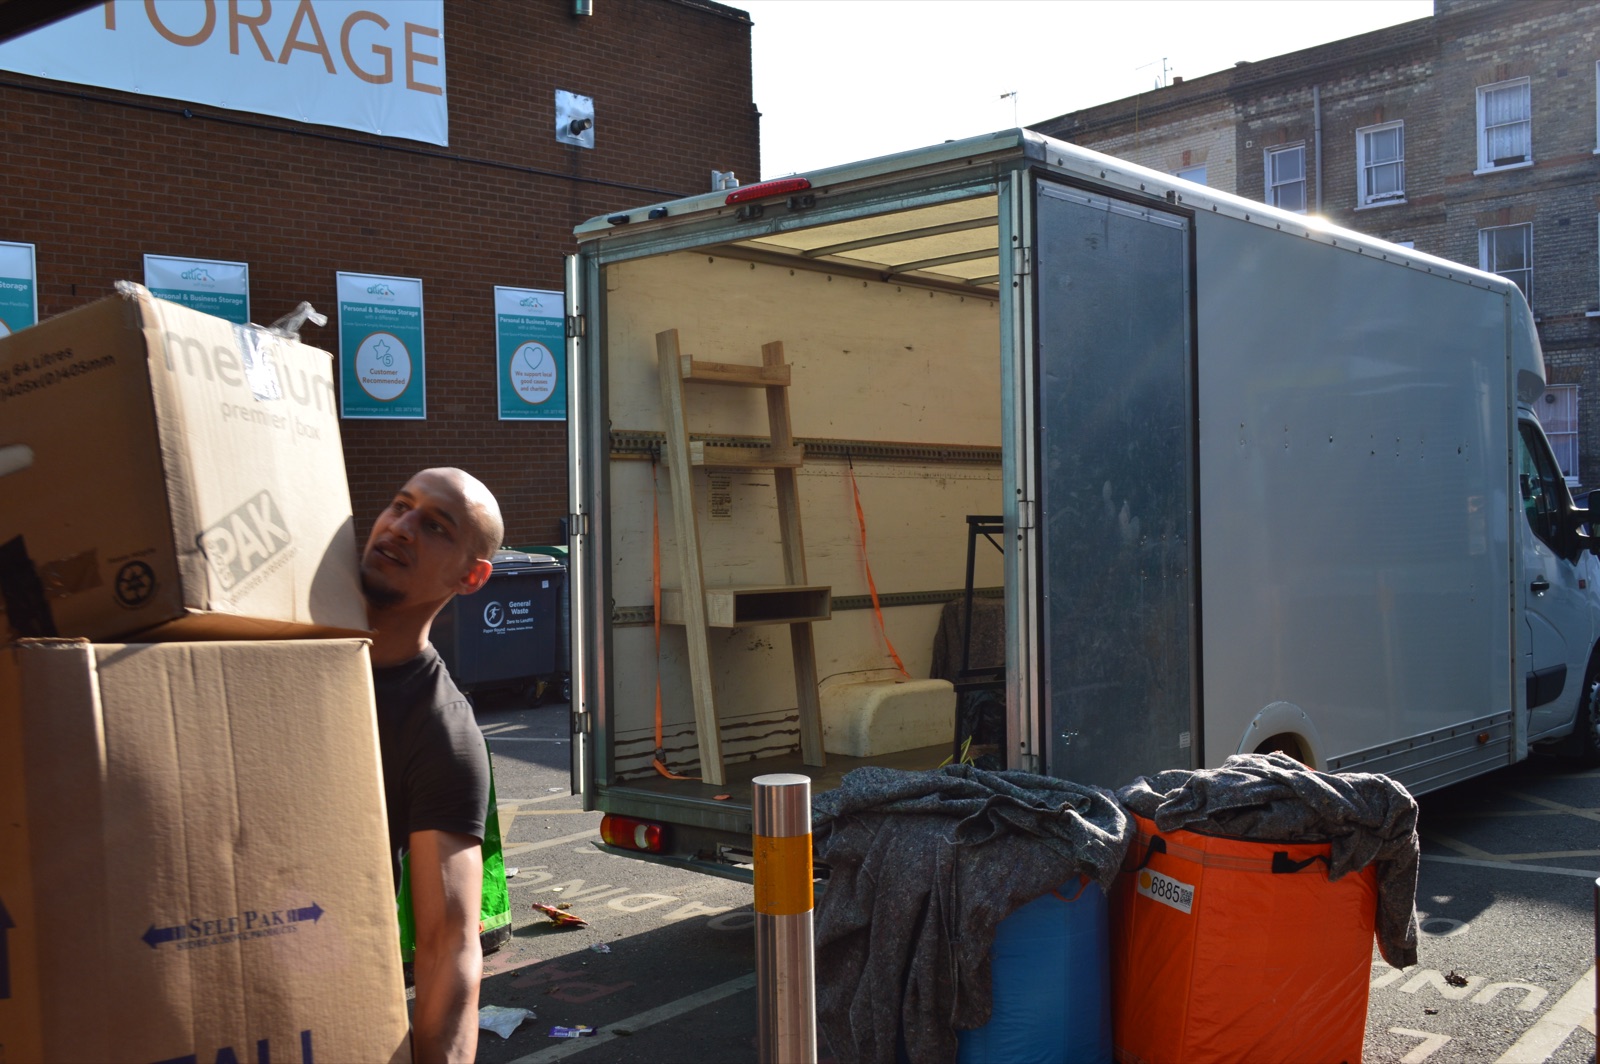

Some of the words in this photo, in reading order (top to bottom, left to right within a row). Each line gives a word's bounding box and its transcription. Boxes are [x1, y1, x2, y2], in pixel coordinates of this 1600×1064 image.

[190, 294, 218, 302] Business
[218, 296, 244, 305] Storage
[397, 309, 419, 318] Storage
[166, 331, 334, 416] meium
[203, 492, 290, 589] PAK
[509, 600, 531, 608] General
[505, 864, 756, 932] OADING
[1151, 876, 1180, 903] 6885
[188, 916, 238, 938] SELF
[244, 910, 284, 930] PAK
